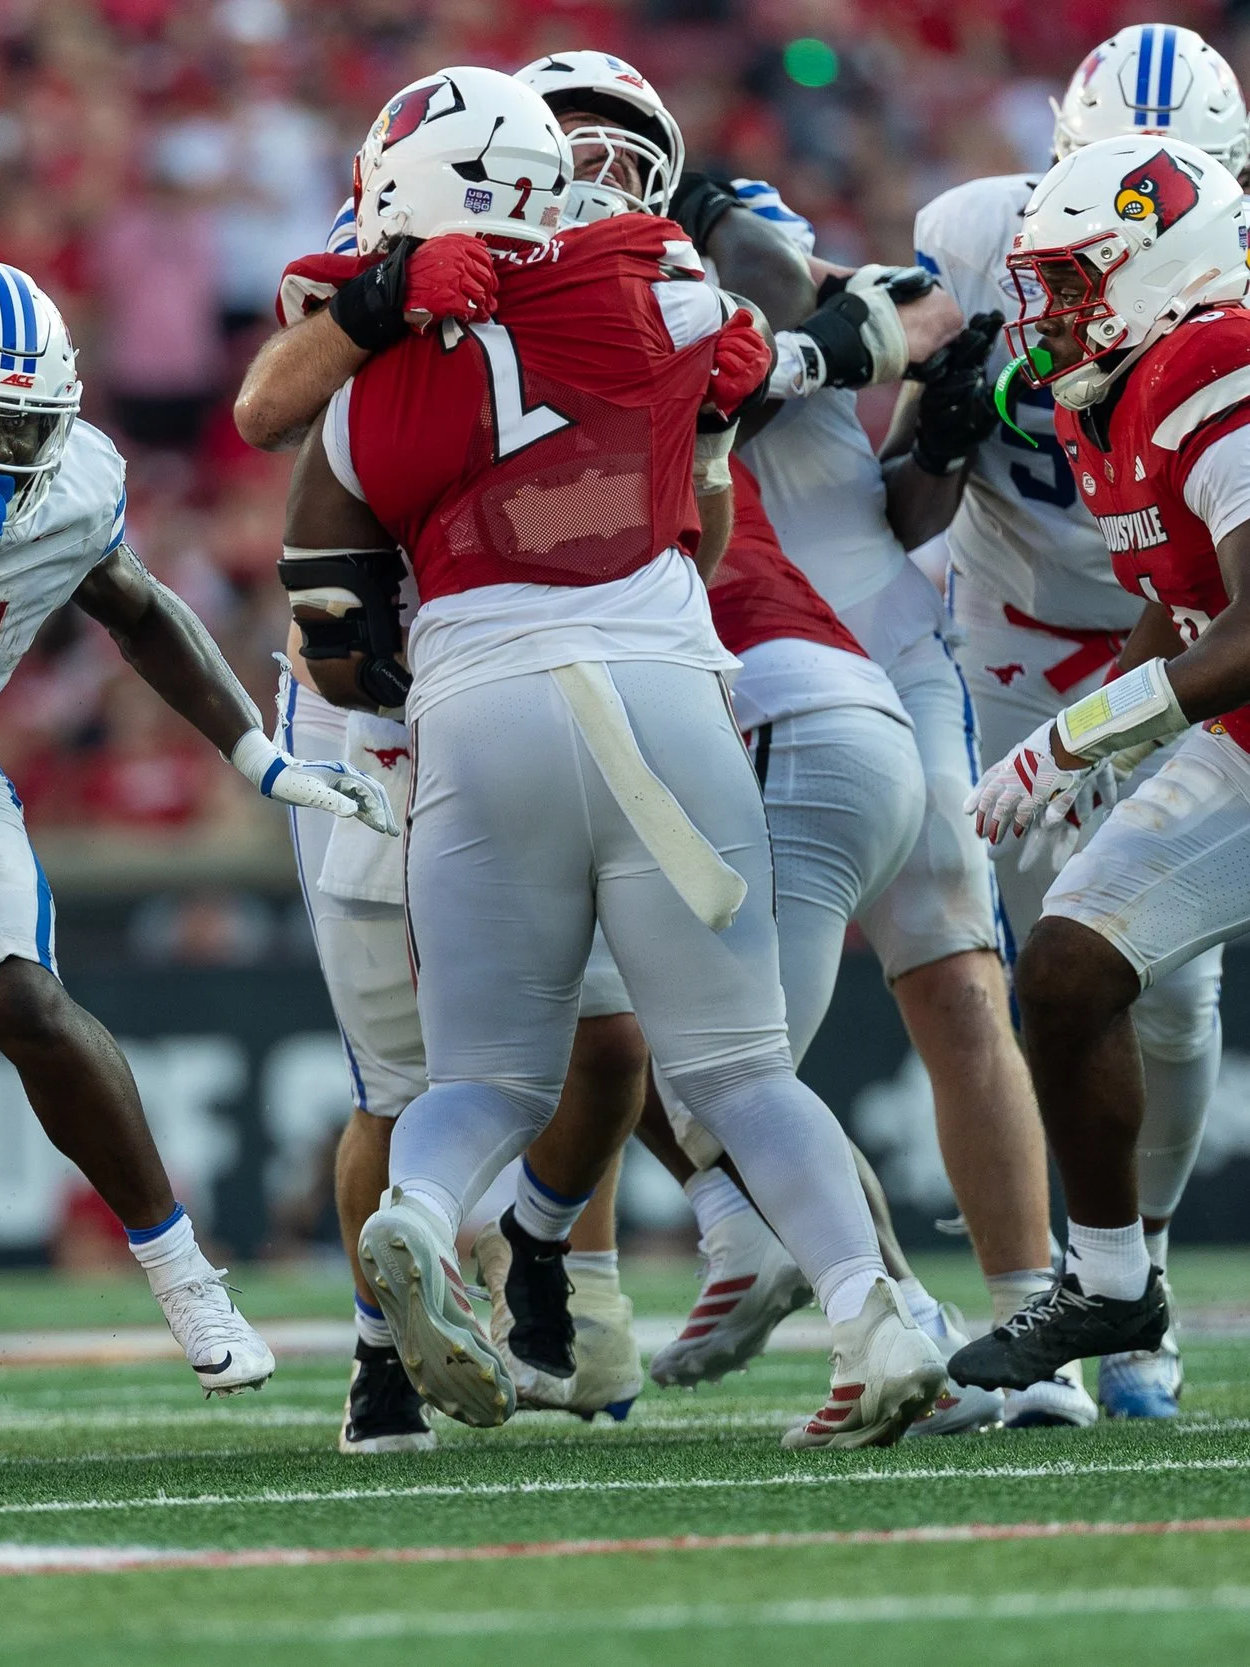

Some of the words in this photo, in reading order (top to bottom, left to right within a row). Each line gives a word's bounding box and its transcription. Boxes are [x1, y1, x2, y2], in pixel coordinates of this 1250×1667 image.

[468, 190, 491, 200] USA
[507, 177, 533, 220] 2
[464, 200, 491, 212] 250
[0, 373, 36, 389] ACC
[437, 313, 579, 464] 2
